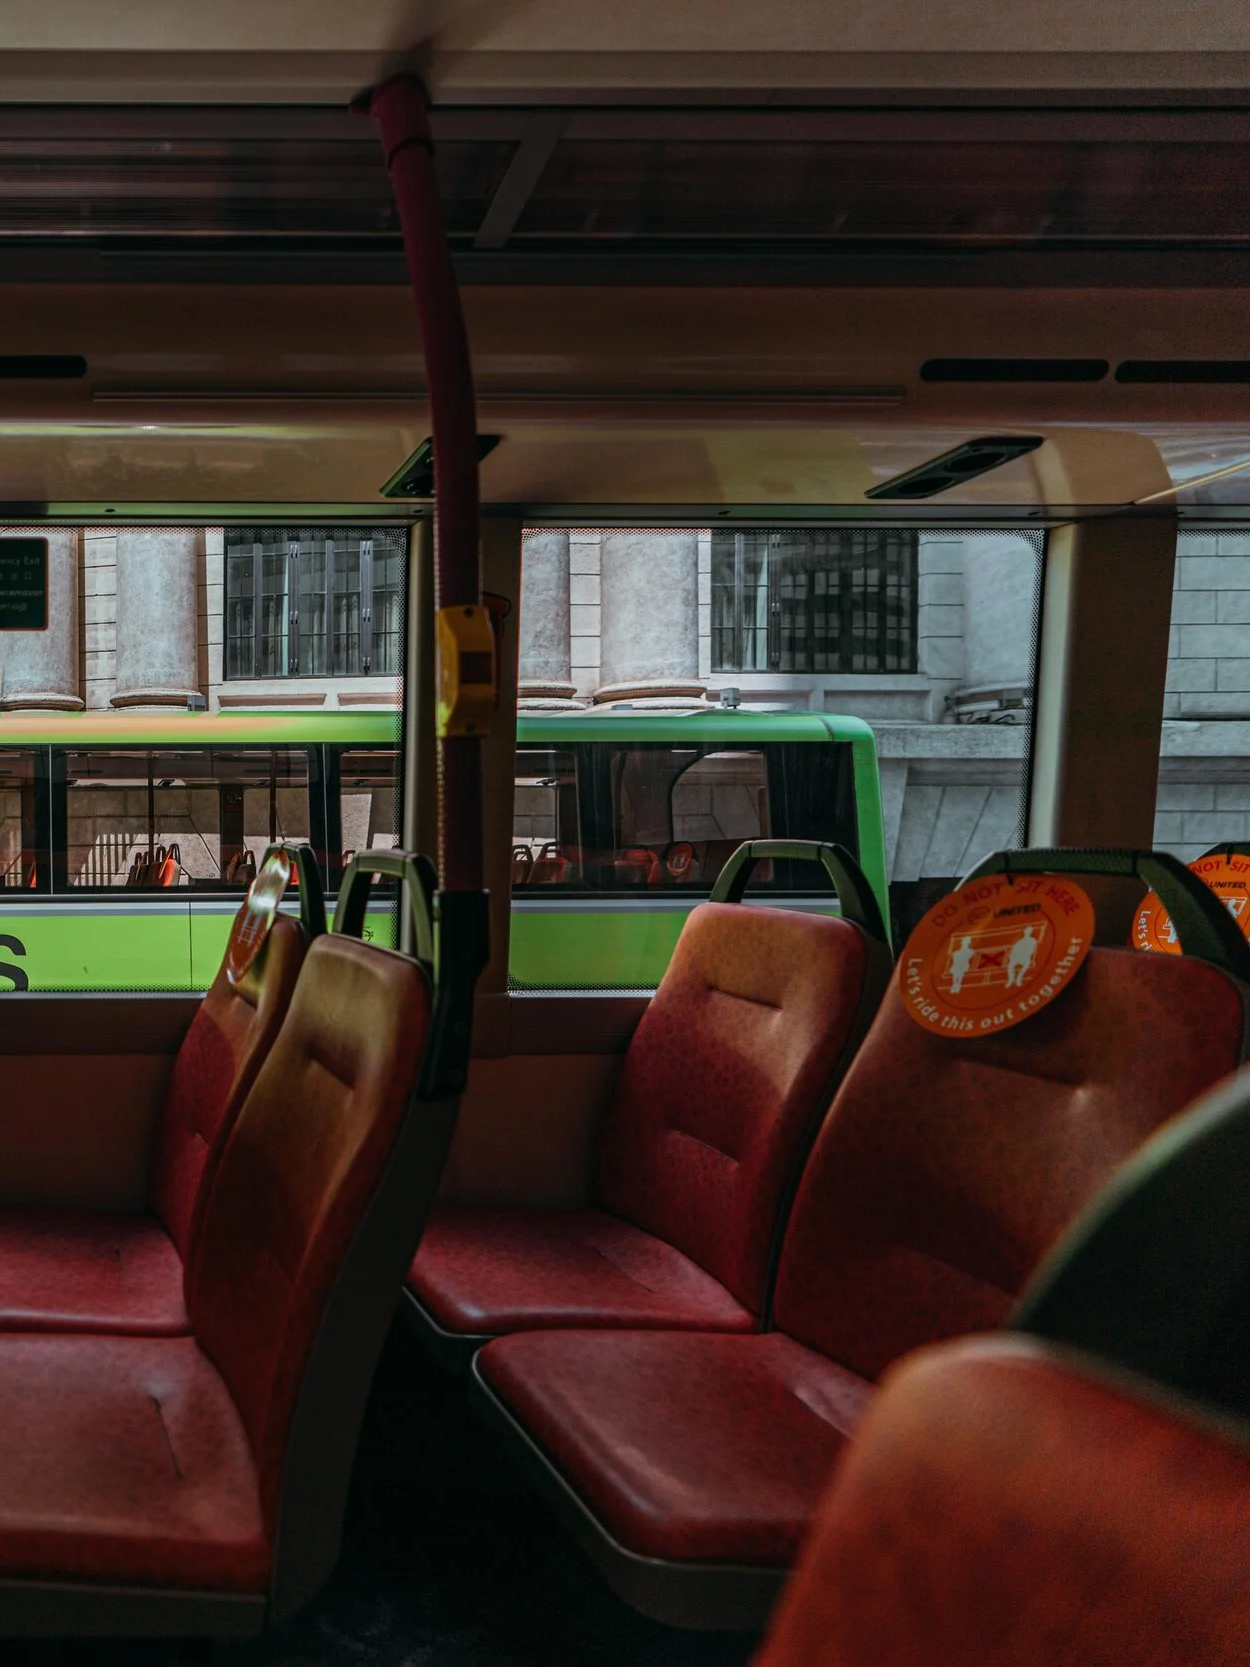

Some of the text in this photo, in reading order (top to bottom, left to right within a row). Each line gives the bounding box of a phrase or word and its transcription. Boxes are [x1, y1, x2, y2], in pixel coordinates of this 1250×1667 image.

[24, 556, 40, 565] Exit
[1209, 881, 1247, 889] UNITED
[931, 903, 958, 928] DO
[962, 882, 1003, 907] NOT
[1015, 879, 1046, 895] SIT
[1045, 884, 1081, 918] HERE
[994, 904, 1042, 918] UNITED
[1137, 911, 1151, 939] Let's
[906, 936, 1083, 1031] Let's ride this out together
